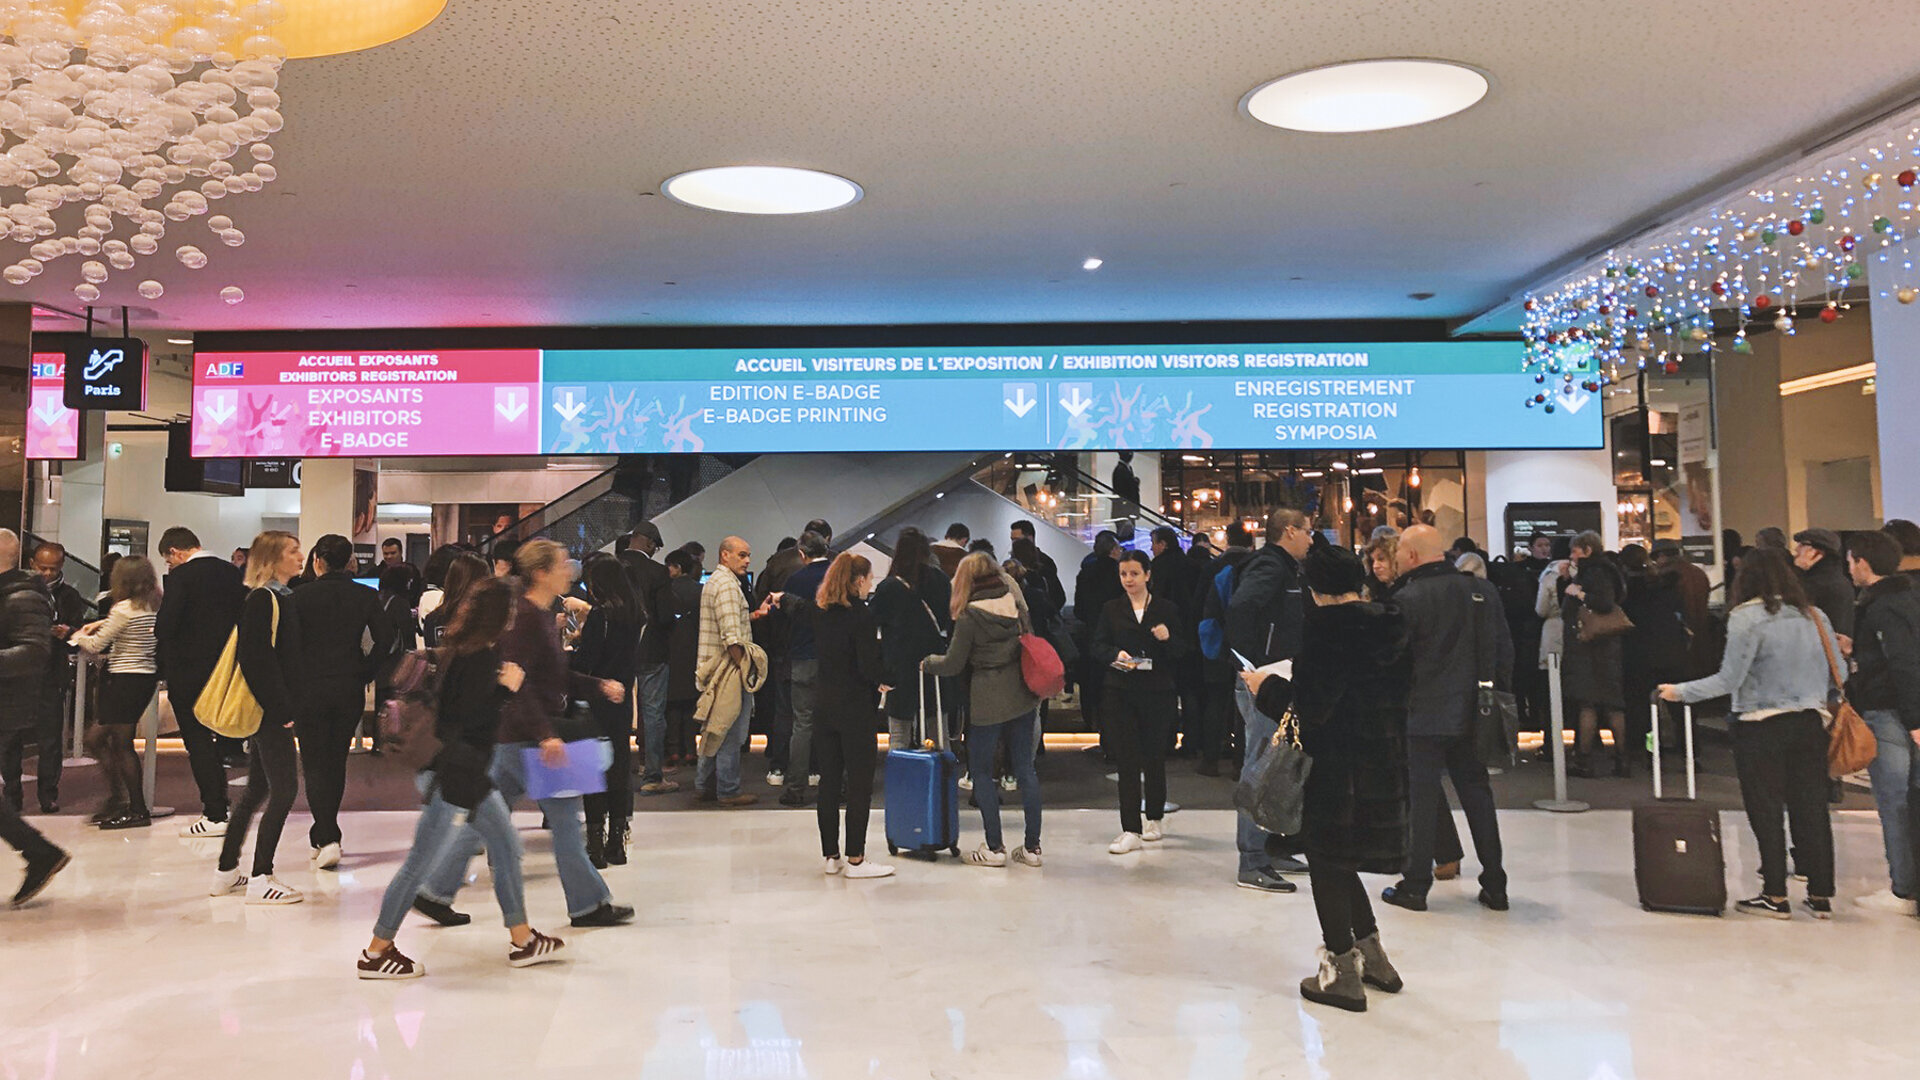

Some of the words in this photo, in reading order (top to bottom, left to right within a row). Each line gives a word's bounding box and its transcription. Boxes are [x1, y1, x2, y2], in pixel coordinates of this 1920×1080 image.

[299, 356, 355, 366] ACCUEIL
[359, 355, 438, 365] EXPOSANTS
[736, 359, 806, 372] ACCUEIL
[812, 358, 896, 371] VISITEURS
[901, 358, 923, 370] DE
[928, 356, 1042, 370] L'EXPOSITION
[1063, 355, 1157, 369] EXHIBITION
[1162, 354, 1239, 368] VISITORS
[1245, 353, 1368, 367] REGISTRATION
[206, 363, 243, 376] ADF
[280, 372, 356, 381] EXHIBITORS
[362, 371, 456, 381] REGISTRATION
[84, 384, 121, 396] Paris
[711, 386, 786, 400] EDITION
[794, 385, 880, 400] E-BADGE
[1236, 380, 1415, 396] ENREGISTREMENT
[309, 388, 422, 404] EXPOSANTS
[309, 411, 421, 425] EXHIBITORS
[704, 408, 791, 423] E-BADGE
[798, 408, 886, 422] PRINTING
[1254, 403, 1396, 418] REGISTRATION
[322, 432, 408, 447] E-BADGE
[1276, 425, 1376, 440] SYMPOSIA
